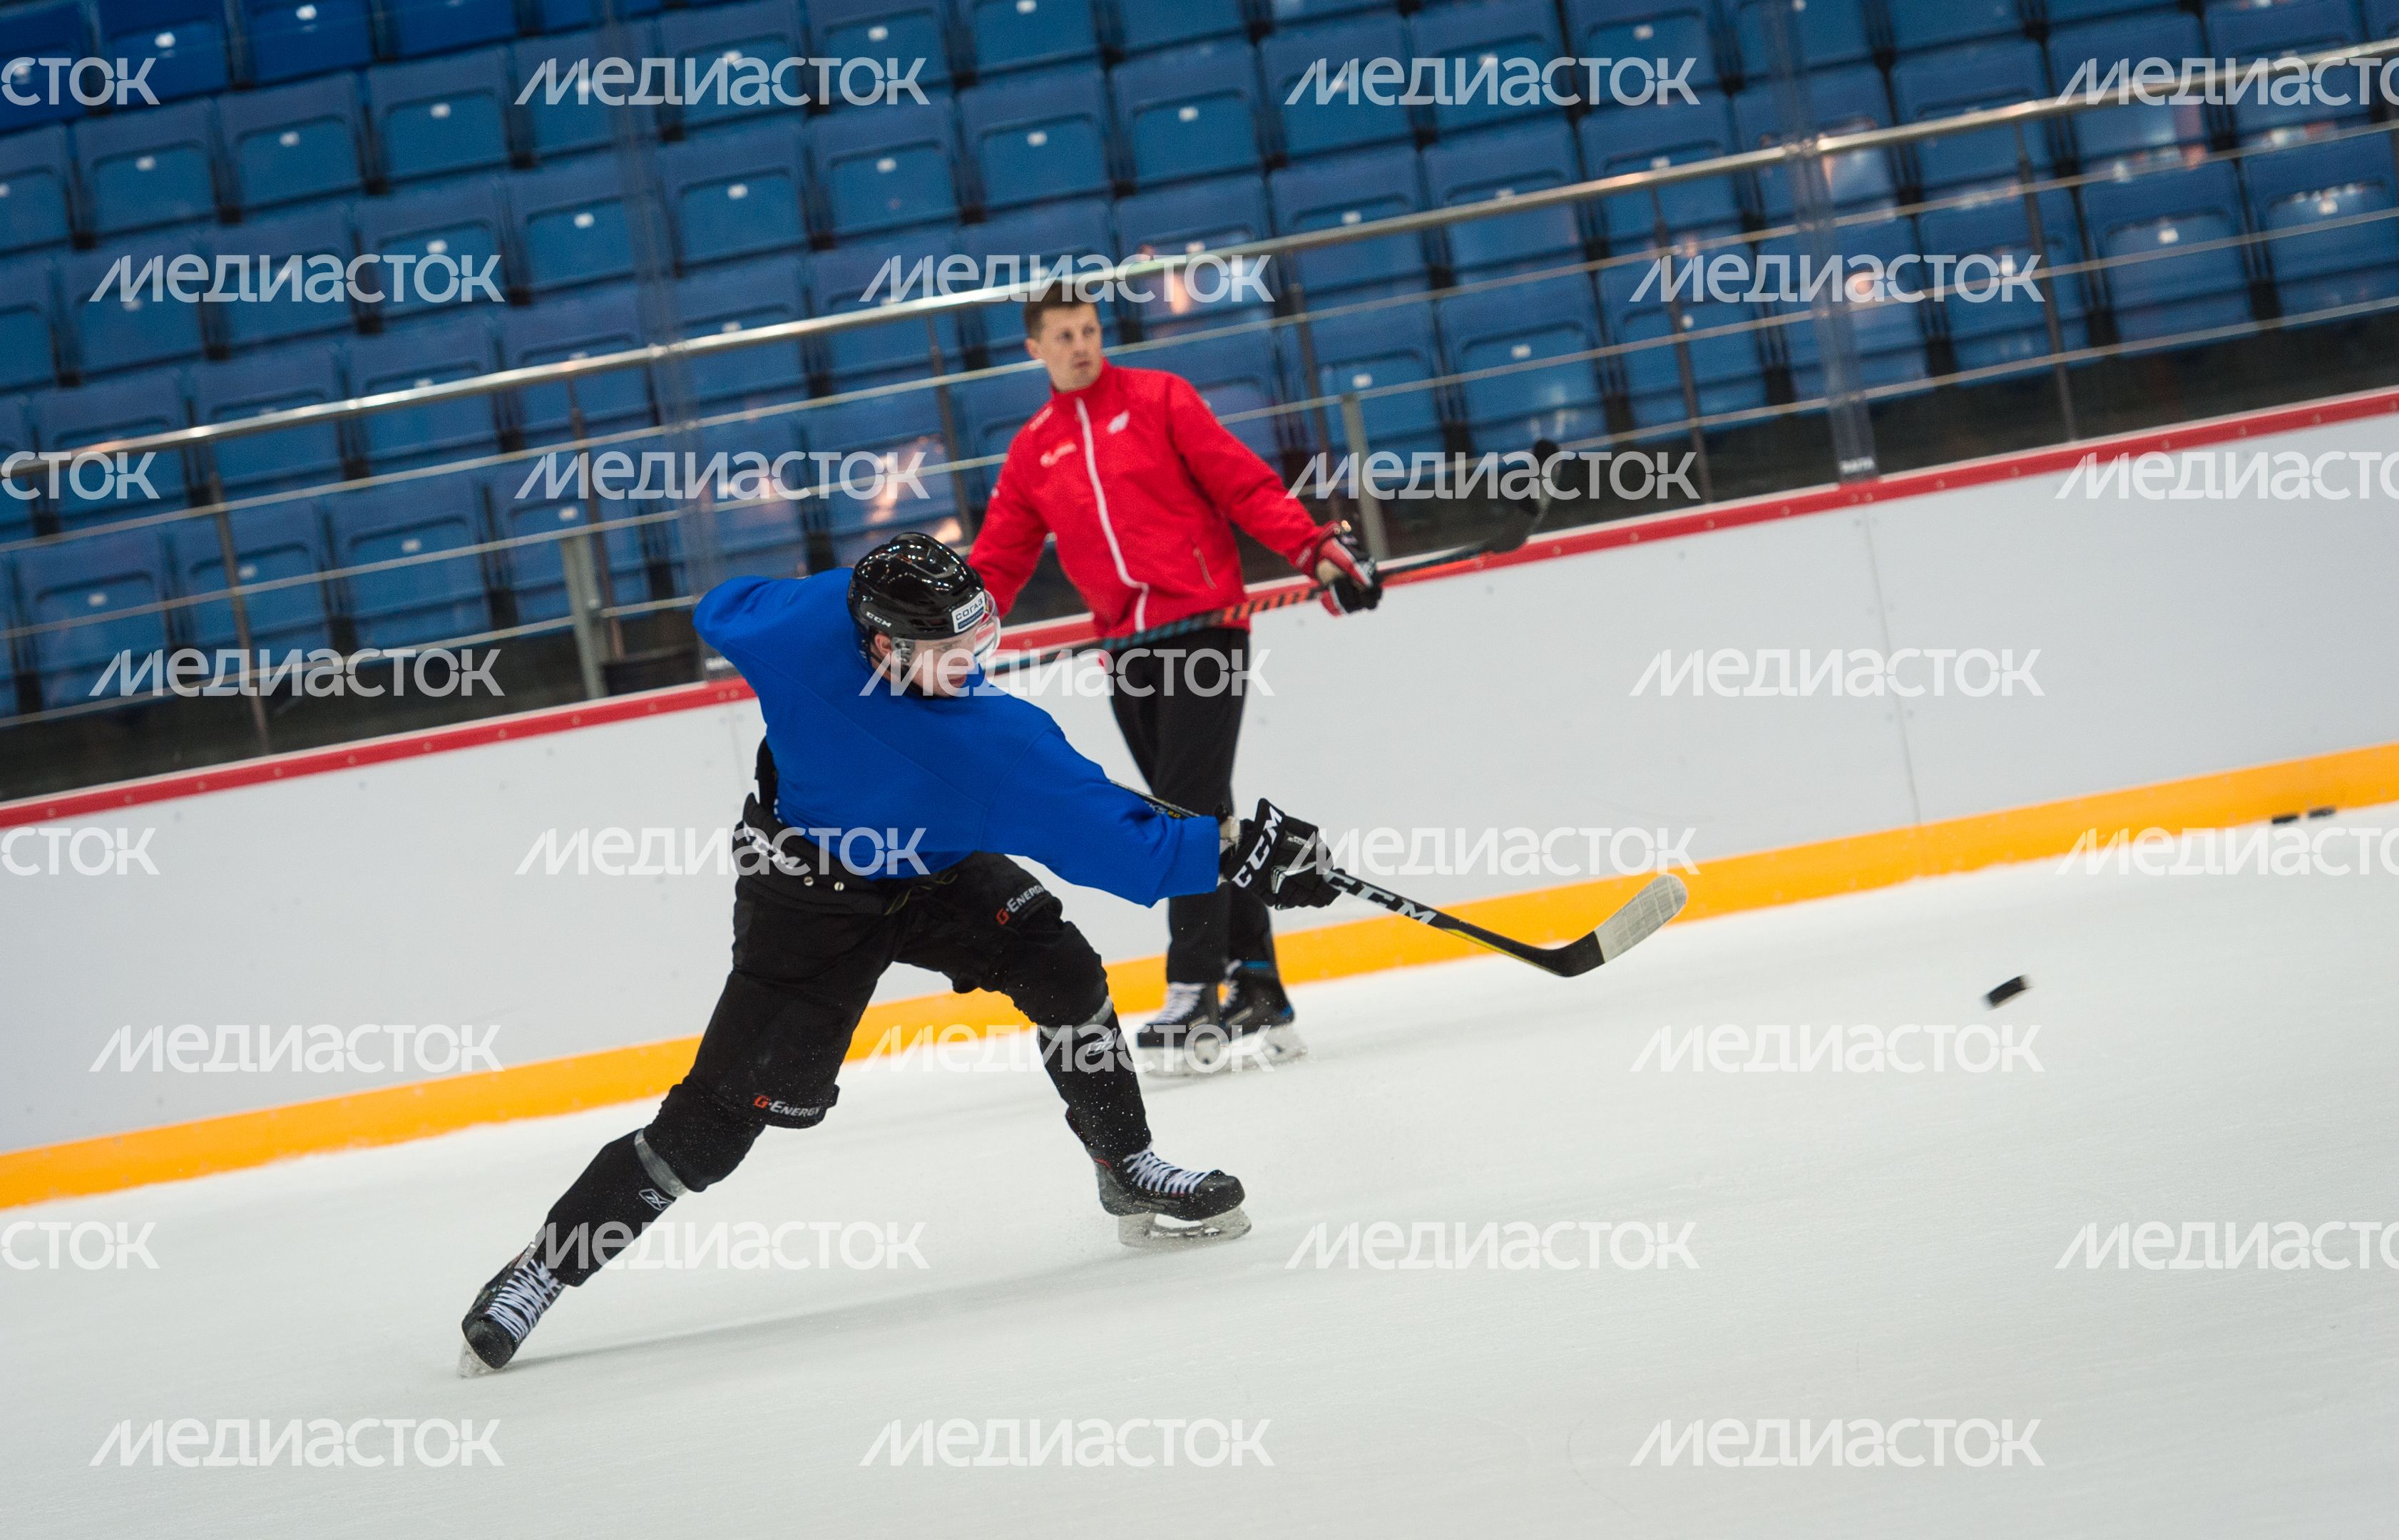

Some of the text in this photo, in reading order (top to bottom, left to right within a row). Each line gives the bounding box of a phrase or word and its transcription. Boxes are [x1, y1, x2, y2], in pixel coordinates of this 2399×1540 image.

[866, 611, 892, 628] CCM
[956, 597, 983, 621] СОГАЗ
[1232, 806, 1283, 888] CCM
[1323, 868, 1438, 925] CCM
